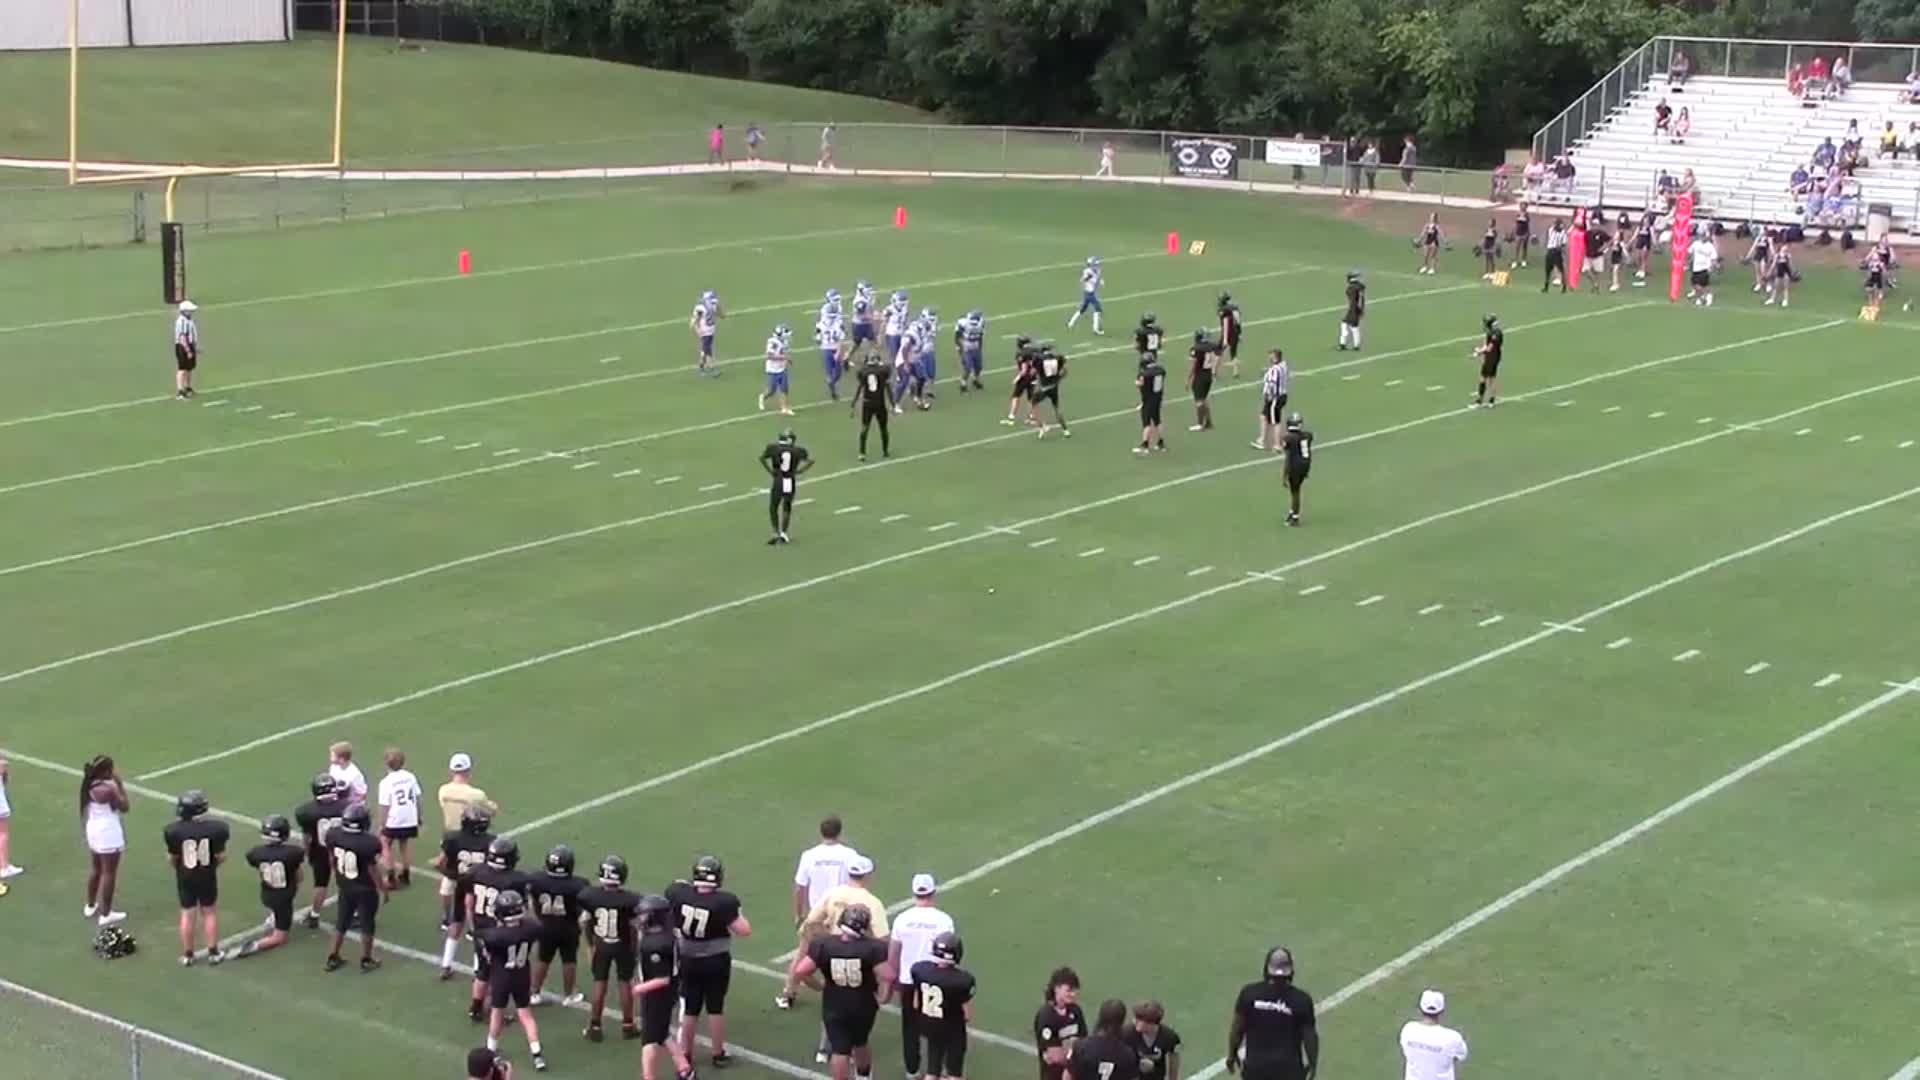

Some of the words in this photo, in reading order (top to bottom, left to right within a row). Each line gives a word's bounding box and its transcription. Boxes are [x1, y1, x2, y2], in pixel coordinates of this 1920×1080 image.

[395, 789, 416, 807] 24
[182, 838, 210, 869] 64
[594, 907, 618, 938] 31
[681, 904, 710, 938] 77
[920, 982, 944, 1019] 12
[1098, 1061, 1115, 1080] 7
